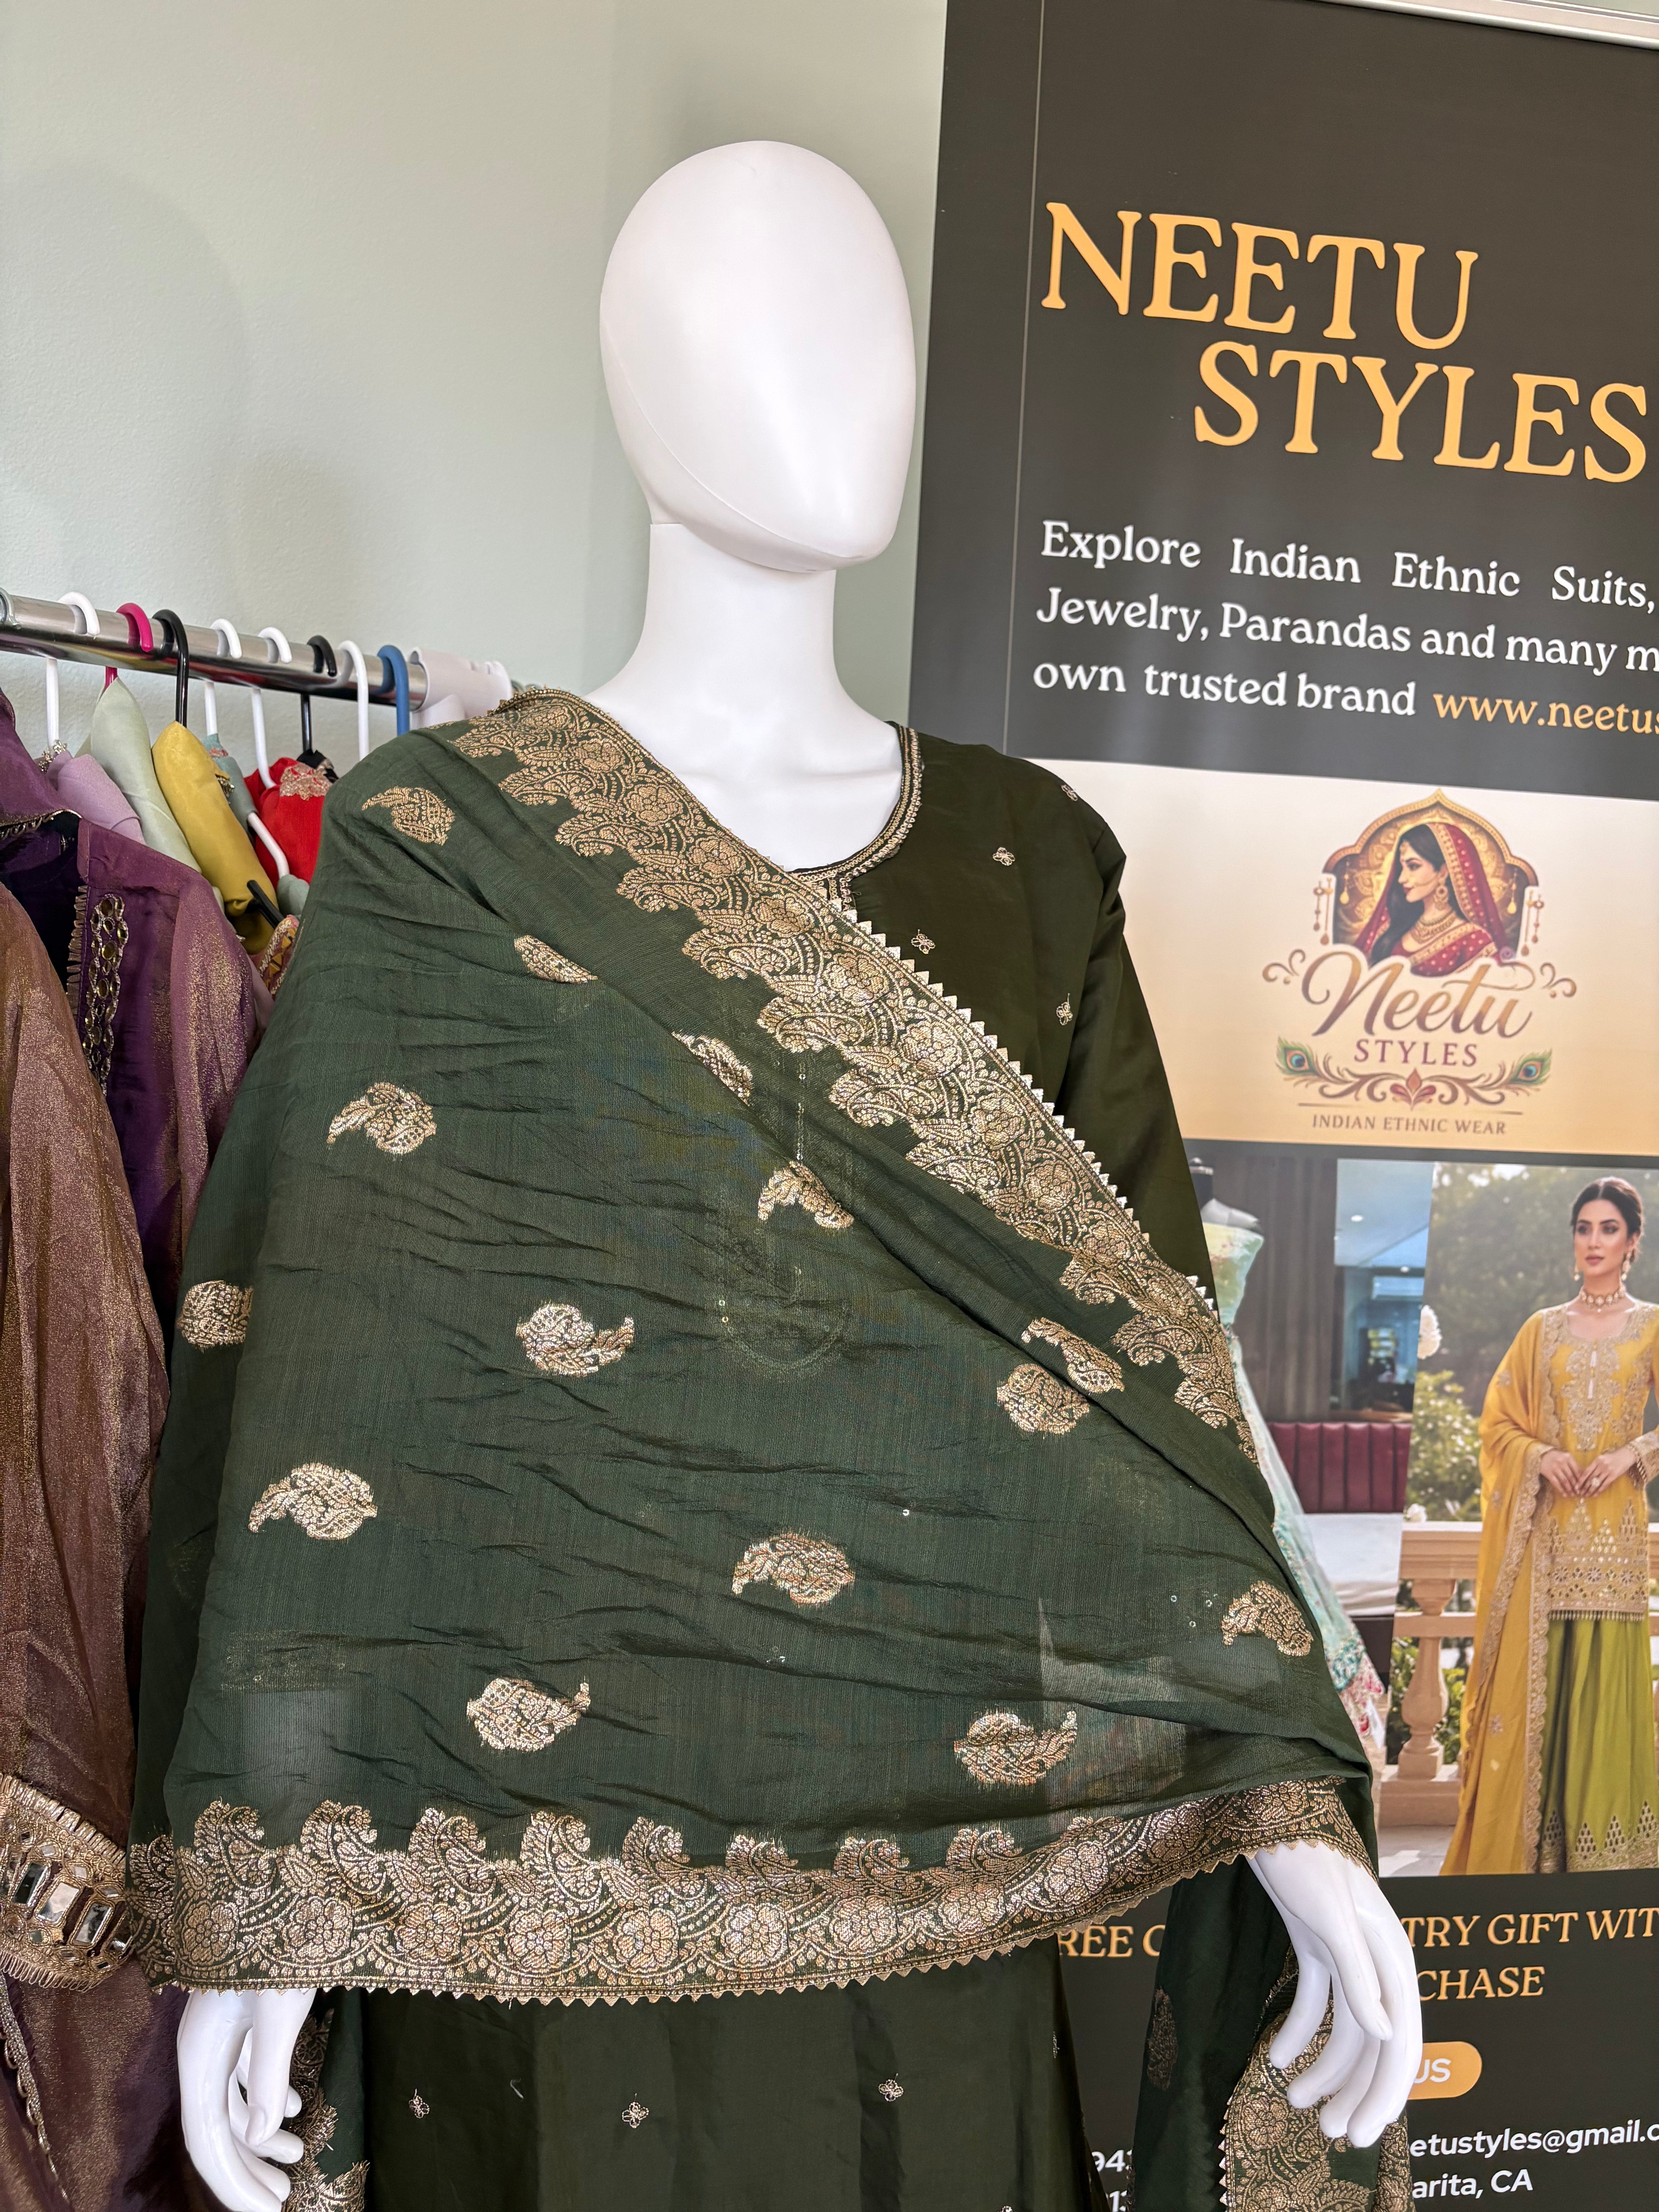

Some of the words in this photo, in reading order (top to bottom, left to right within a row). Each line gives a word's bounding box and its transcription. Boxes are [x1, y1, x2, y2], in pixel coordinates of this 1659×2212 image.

[1041, 202, 1479, 350] NEETU
[1194, 340, 1647, 483] STYLES
[1041, 520, 1201, 569] Explore
[1229, 537, 1361, 584] Indian
[1391, 551, 1520, 597] Ethnic
[1551, 565, 1655, 614] Suits,
[1036, 587, 1209, 642] Jewelry,
[1219, 601, 1411, 652] Parandas
[1421, 623, 1496, 659] and
[1505, 635, 1618, 677] many
[1033, 663, 1127, 693] own
[1144, 664, 1287, 707] trusted
[1297, 672, 1416, 716] brand
[1432, 693, 1659, 735] www.neetu
[1301, 951, 1535, 1037] Neetu
[1353, 1038, 1478, 1068] STYLES
[1312, 1114, 1376, 1130] INDIAN
[1383, 1116, 1448, 1133] ETHNIC
[1454, 1119, 1506, 1135] WEAR
[1399, 1915, 1481, 1948] TRY
[1487, 1912, 1579, 1945] GIFT
[1586, 1907, 1659, 1941] WIT
[1417, 1966, 1545, 2002] CHASE
[1408, 2119, 1659, 2159] etustyles@gmail.c
[1411, 2173, 1484, 2199] arita,
[1491, 2168, 1534, 2193] CA
